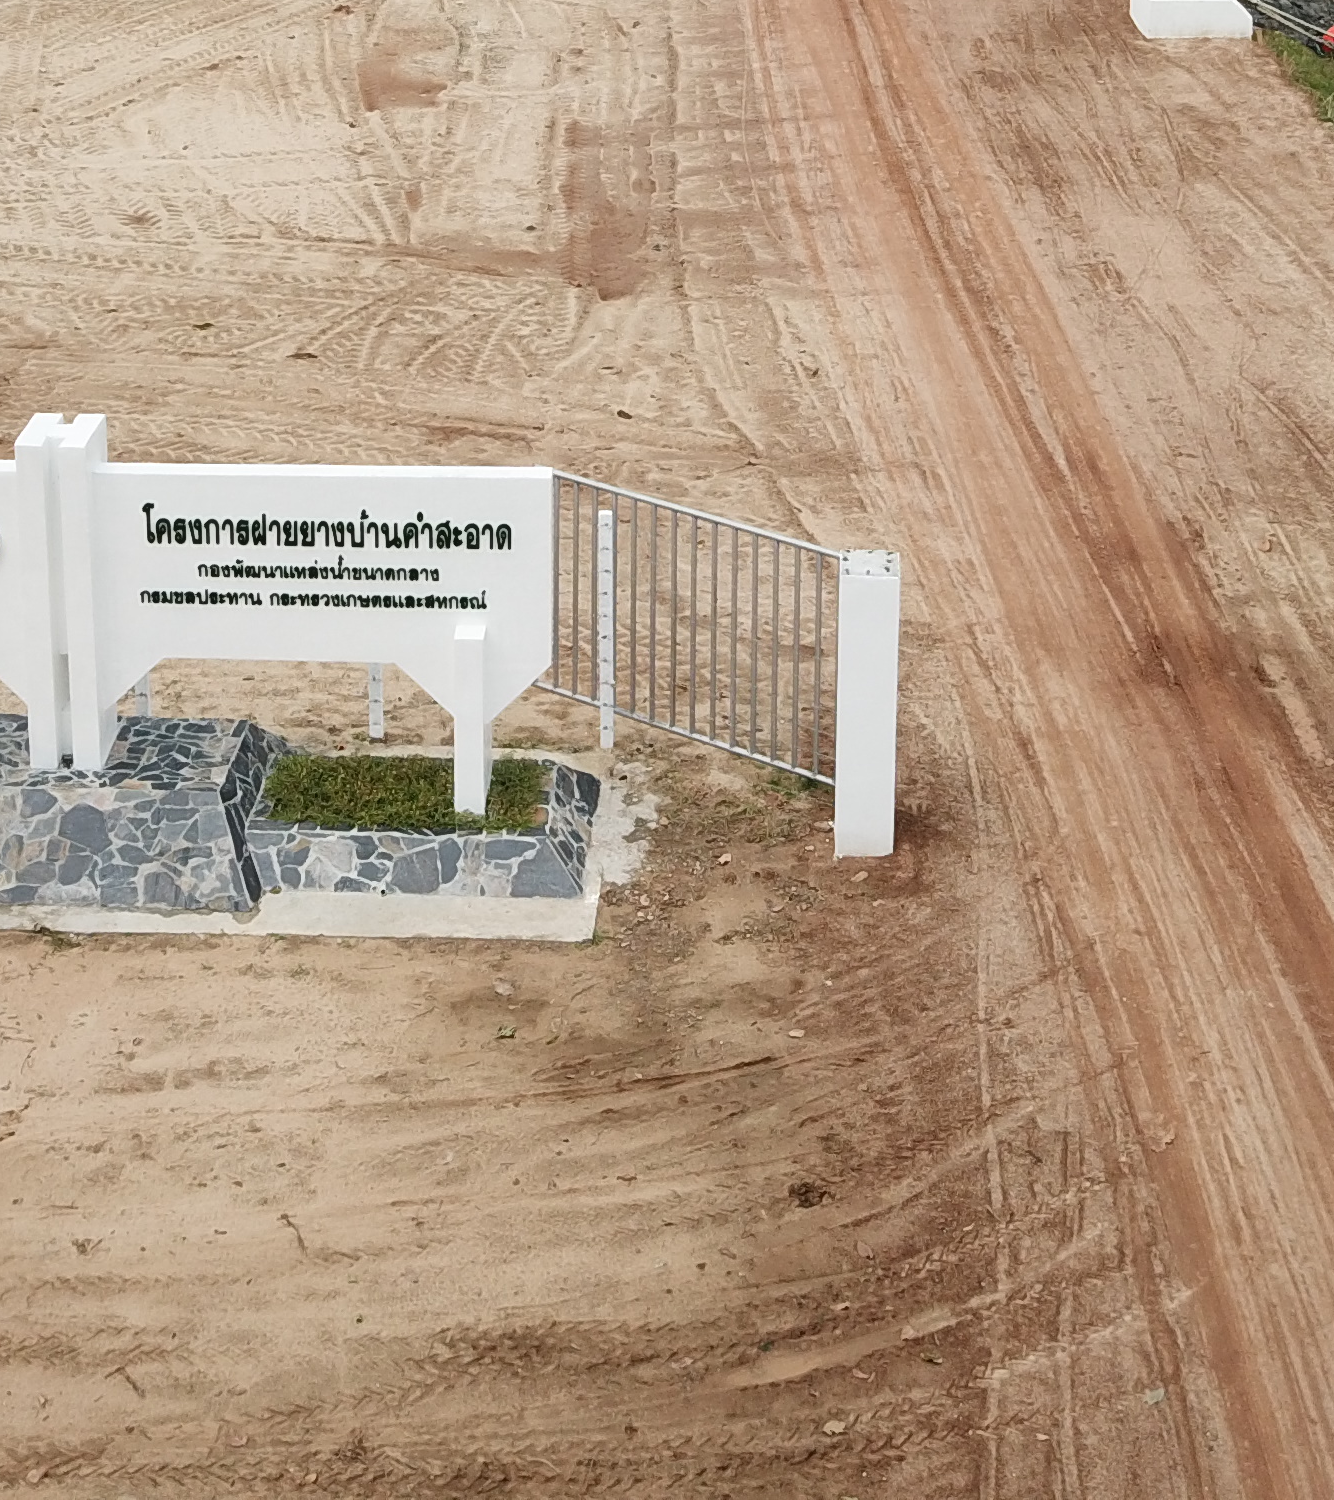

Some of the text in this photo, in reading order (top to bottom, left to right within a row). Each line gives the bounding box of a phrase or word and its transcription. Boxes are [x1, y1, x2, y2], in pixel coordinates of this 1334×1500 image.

[141, 502, 512, 551] โครงการฝายยางบ้านคำสะอาด
[197, 554, 440, 582] กองพัฒนาแหล่งน้ำขนาดกลาง
[139, 588, 488, 610] กรมชลประทาน กระทรวงเกษตรและสหกรณ์
